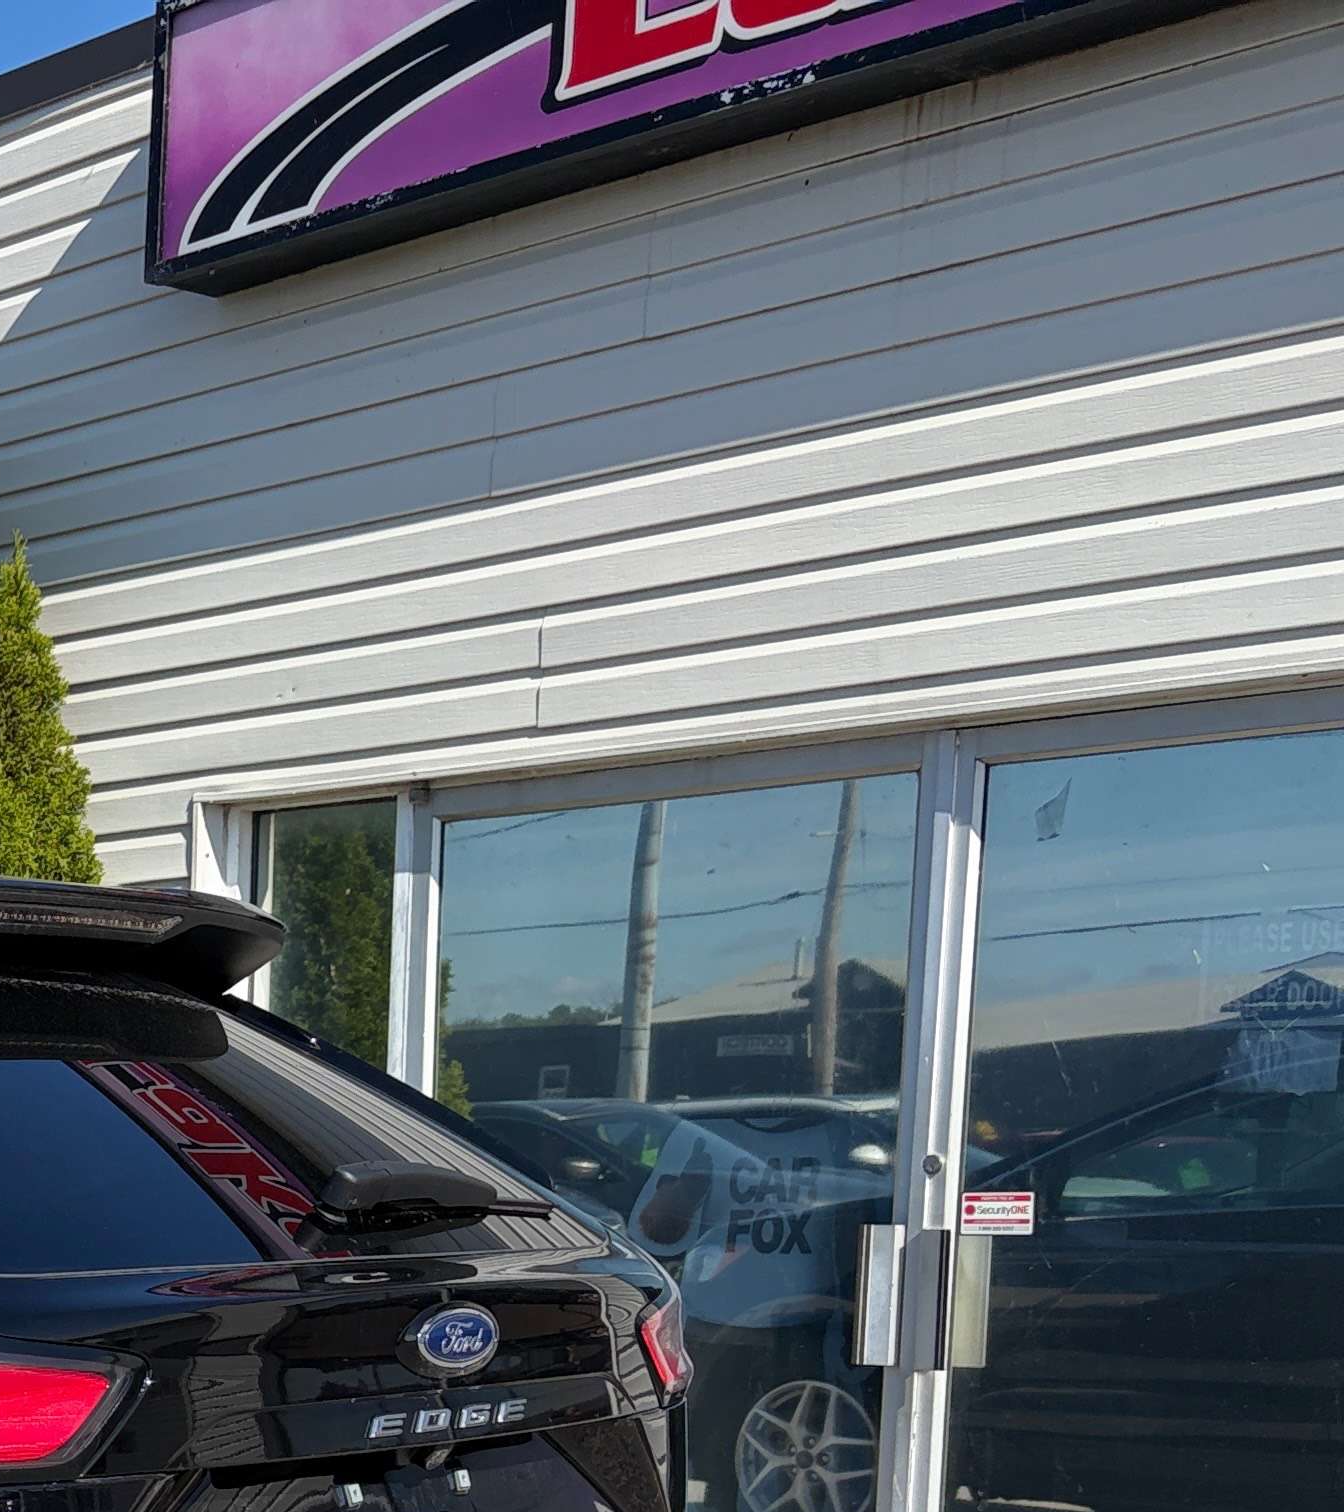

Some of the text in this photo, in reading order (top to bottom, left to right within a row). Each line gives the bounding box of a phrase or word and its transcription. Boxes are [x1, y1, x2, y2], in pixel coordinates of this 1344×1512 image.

[729, 1156, 820, 1204] CAR
[725, 1207, 813, 1255] FOX
[441, 1321, 484, 1355] Ford
[367, 1398, 528, 1438] EDGE
